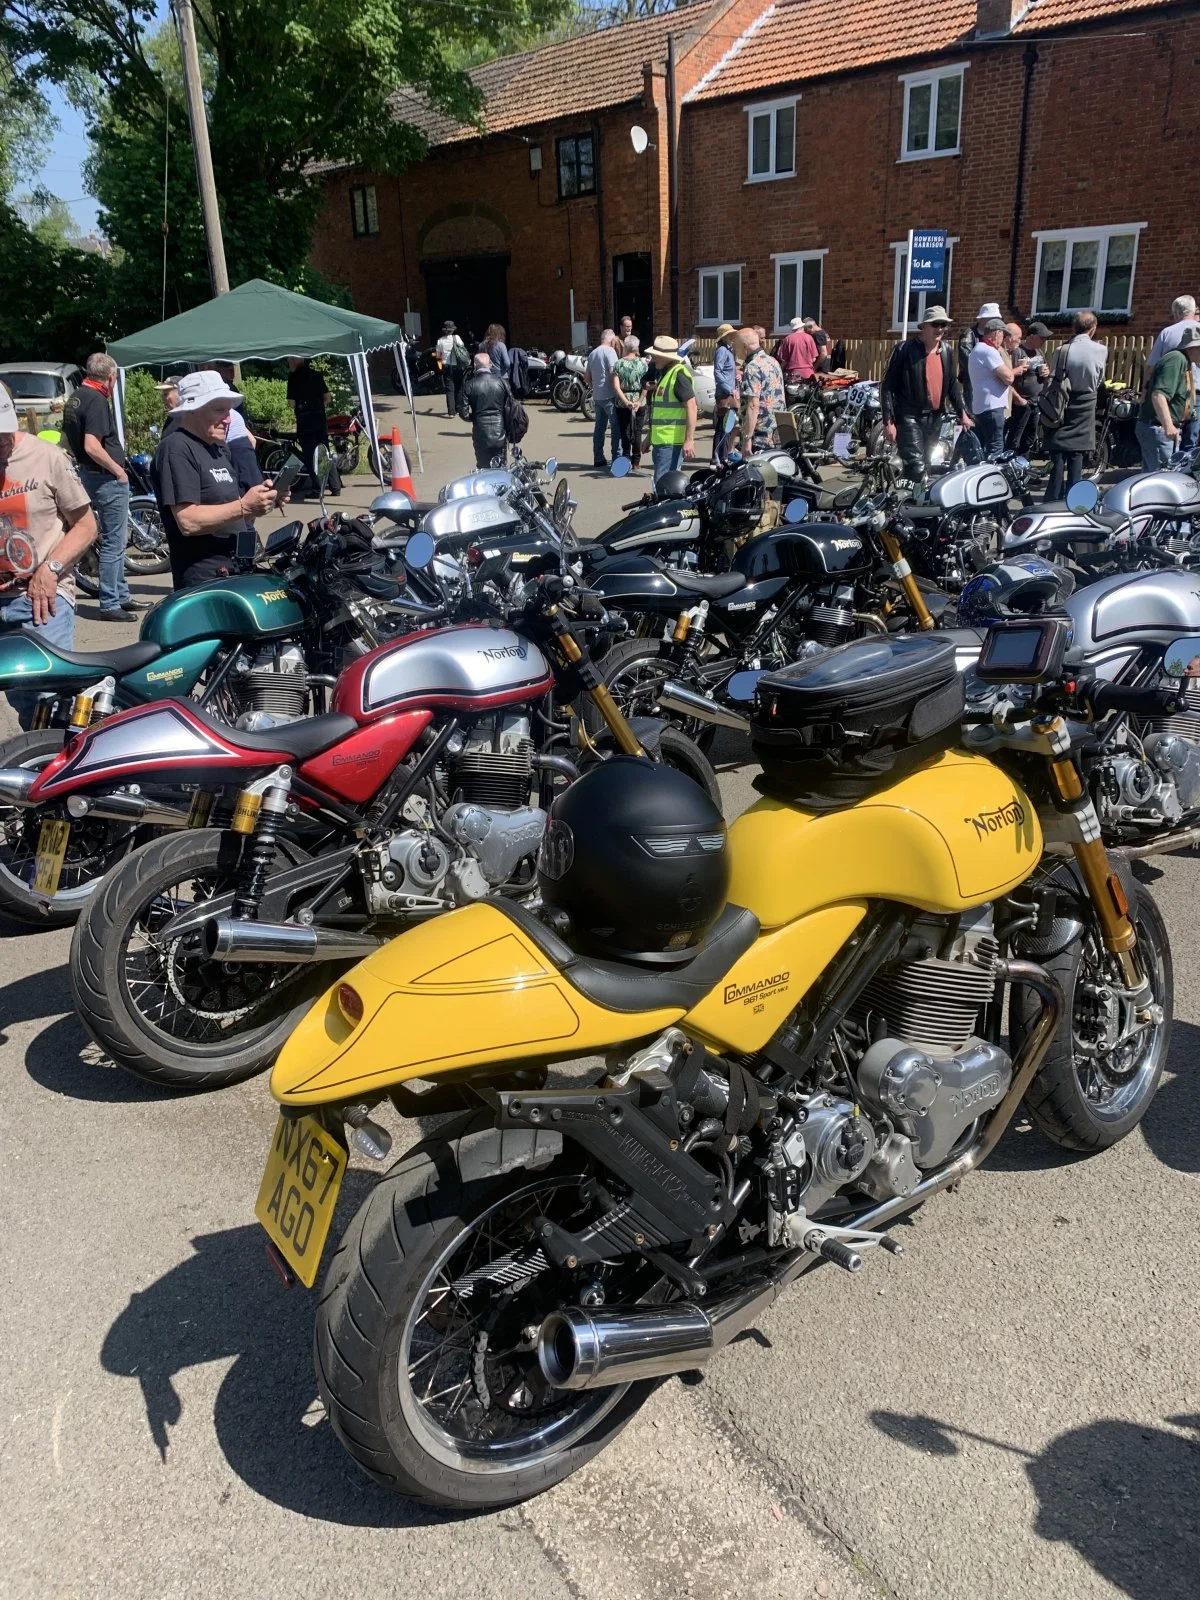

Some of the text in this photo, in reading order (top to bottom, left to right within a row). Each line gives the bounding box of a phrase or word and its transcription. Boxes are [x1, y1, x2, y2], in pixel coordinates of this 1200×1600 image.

[912, 259, 932, 268] To Let
[850, 388, 865, 404] 99
[830, 538, 863, 551] Norton
[477, 645, 527, 664] Norton
[146, 667, 184, 682] COMMANDO
[332, 749, 381, 767] COMMANDO
[963, 801, 1025, 843] Norton
[498, 820, 542, 848] Norton
[723, 971, 790, 1005] COMMANDO
[743, 994, 758, 1006] 961
[759, 988, 777, 1000] Sport
[949, 1071, 1002, 1118] Norton
[275, 1117, 339, 1205] NX67
[267, 1171, 315, 1257] AGO
